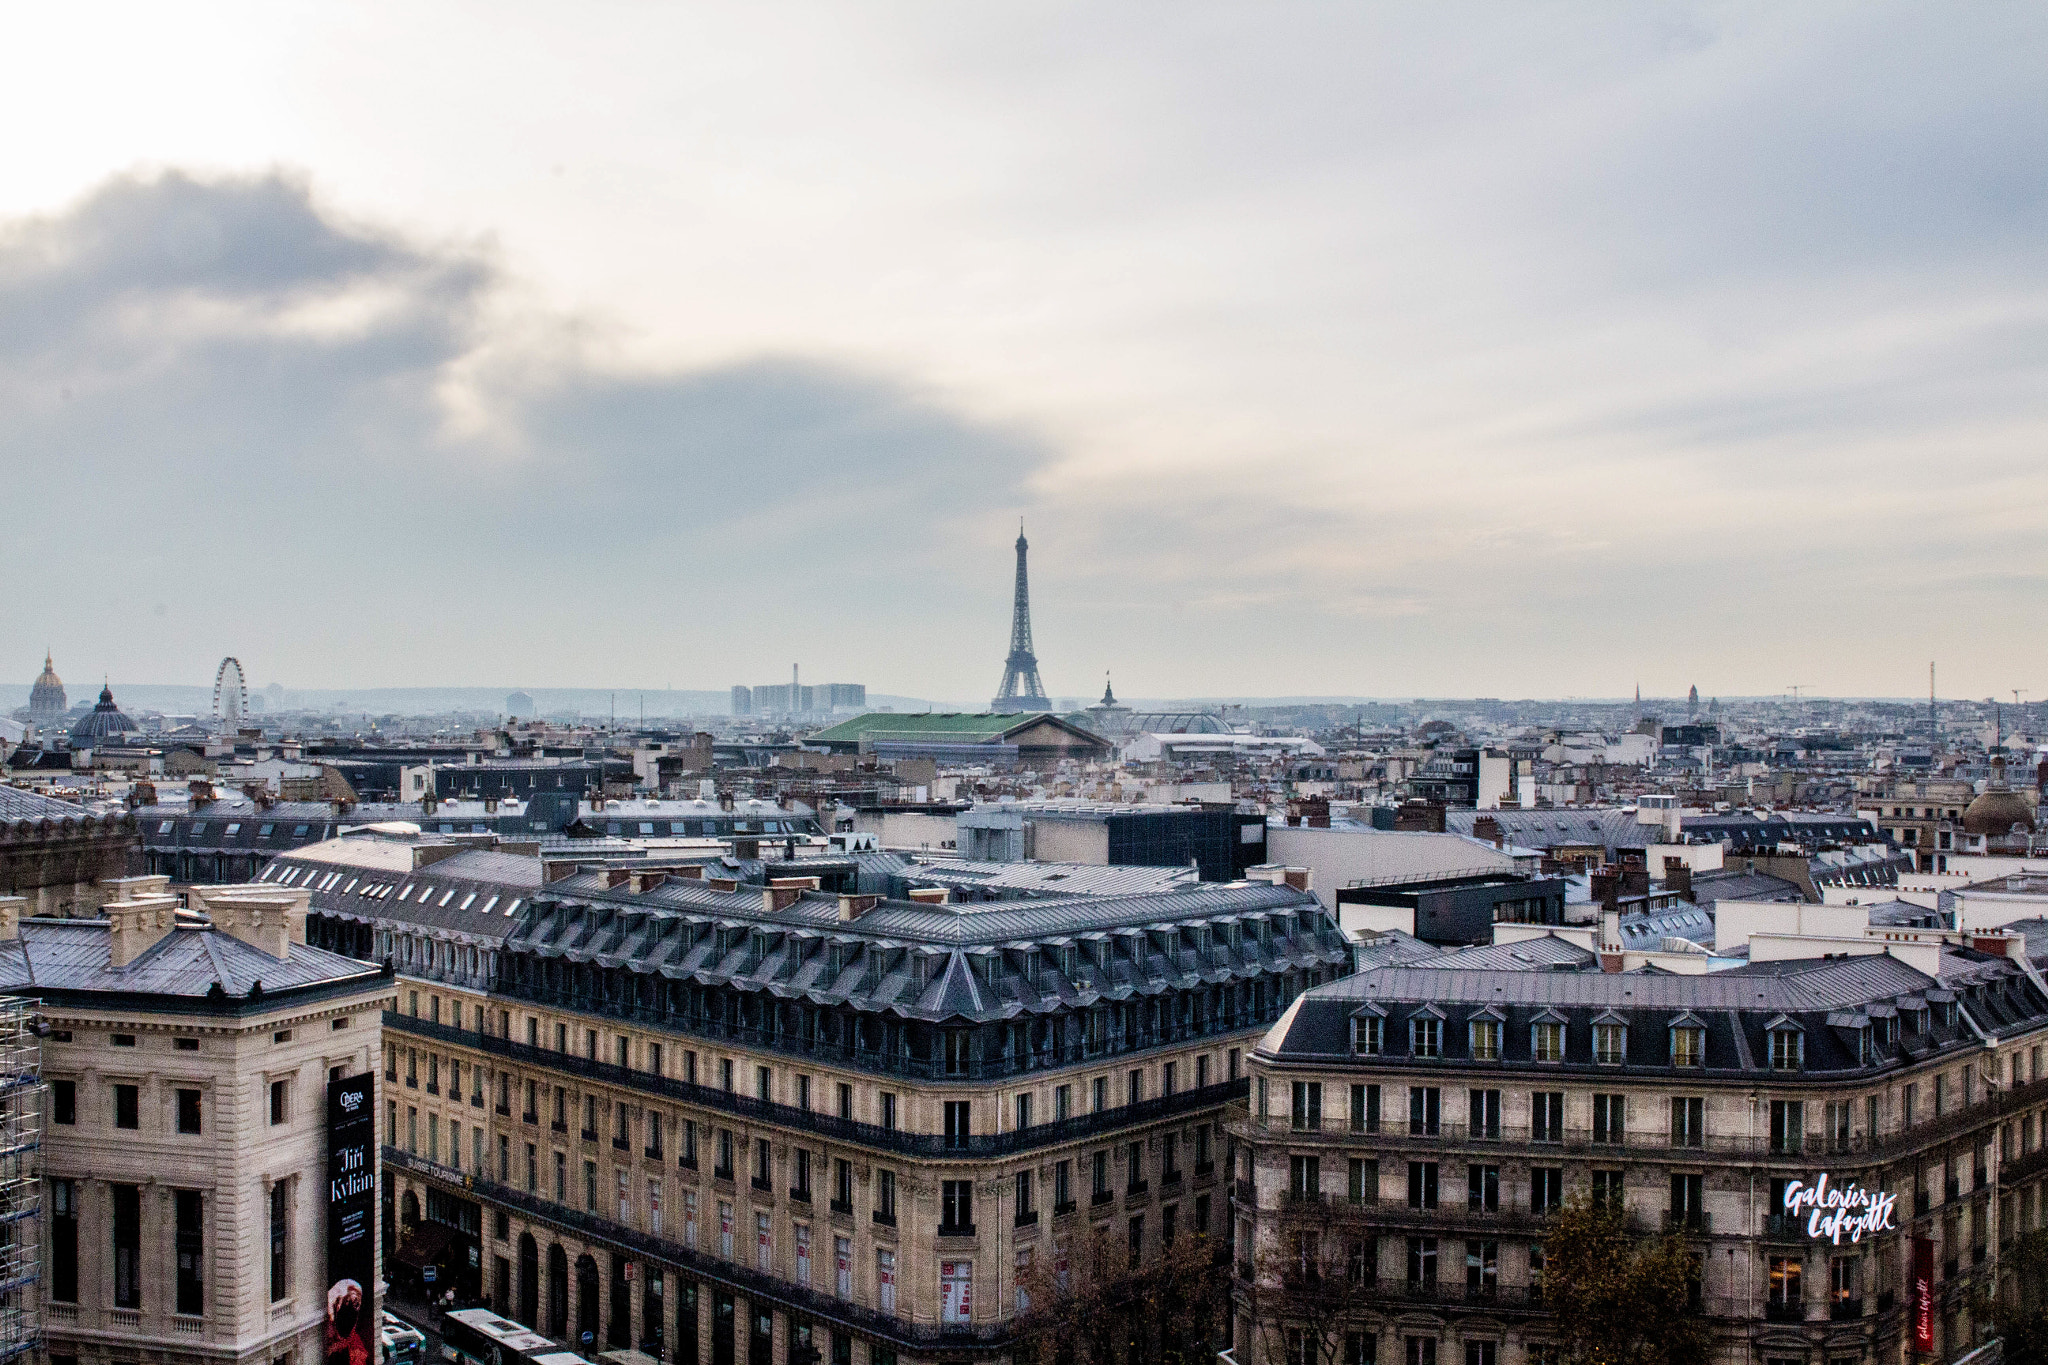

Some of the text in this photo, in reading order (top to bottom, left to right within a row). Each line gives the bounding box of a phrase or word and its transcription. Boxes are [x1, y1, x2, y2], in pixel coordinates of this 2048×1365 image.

[332, 1171, 373, 1203] Kylián
[430, 1167, 463, 1186] TOURISME
[1784, 1173, 1869, 1216] Galeries
[1808, 1192, 1897, 1245] Lafayette
